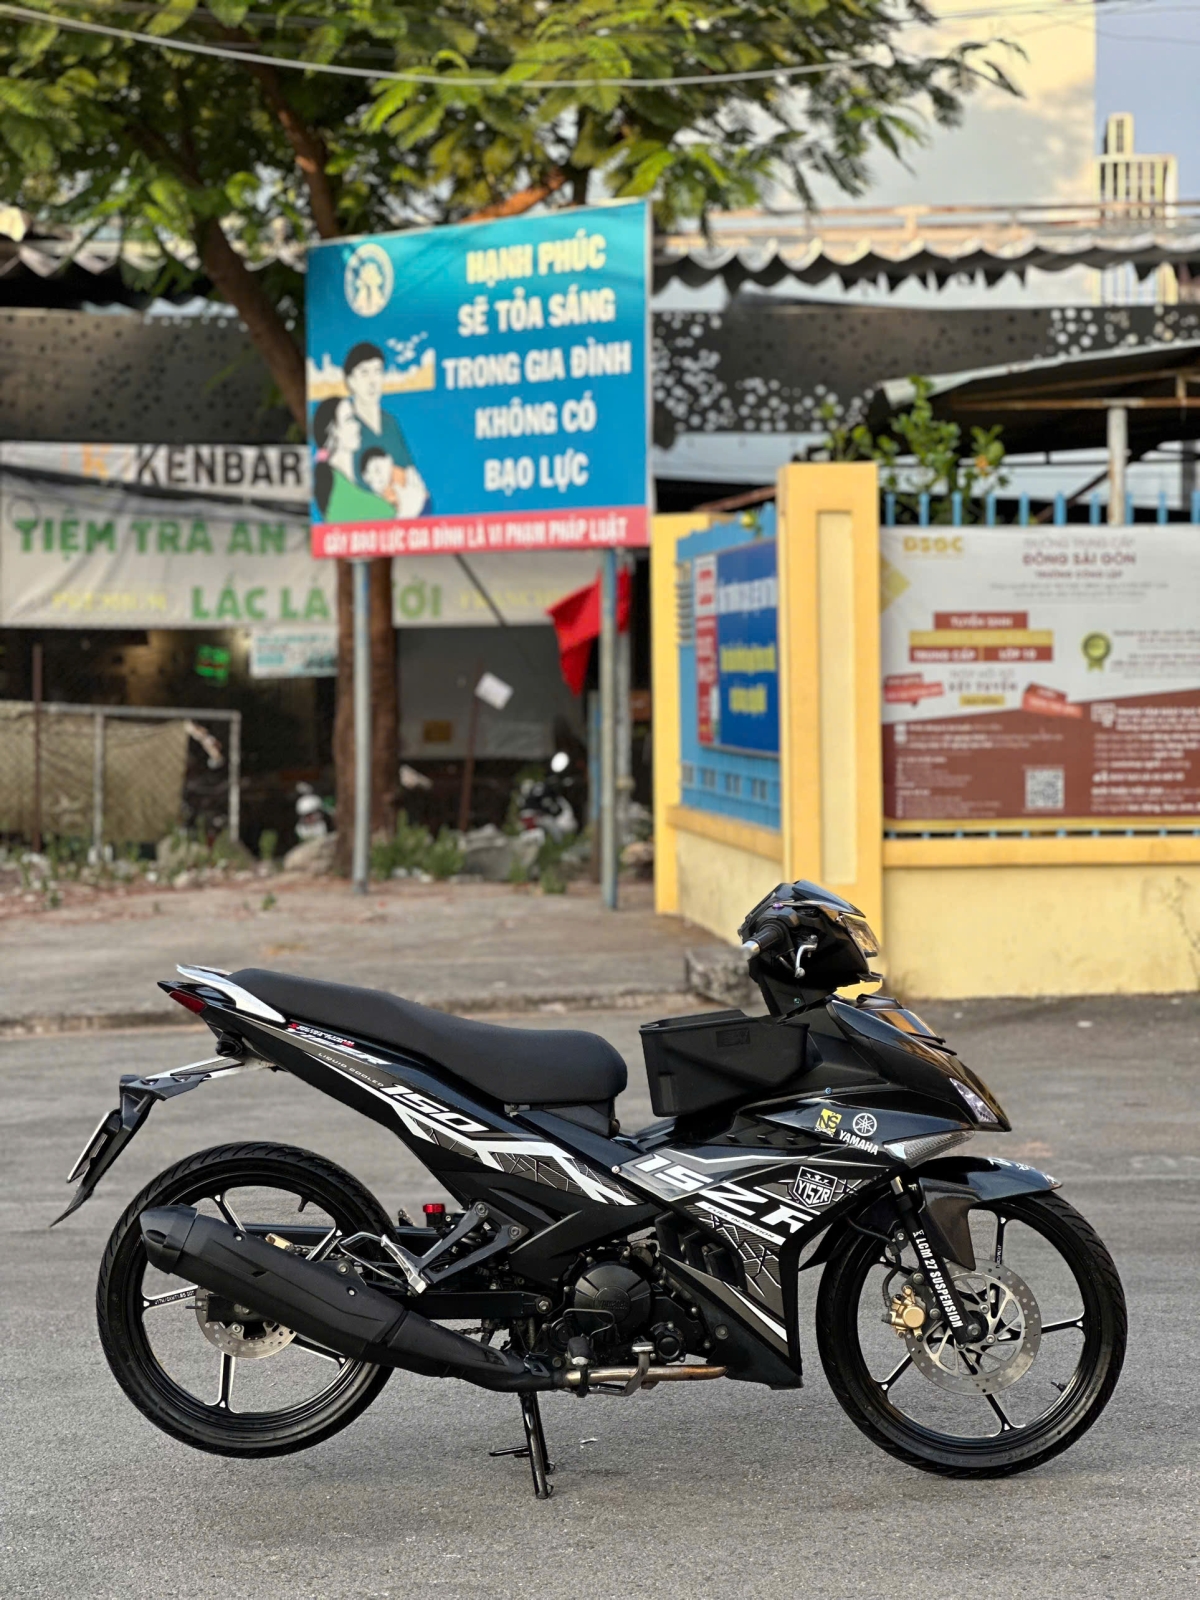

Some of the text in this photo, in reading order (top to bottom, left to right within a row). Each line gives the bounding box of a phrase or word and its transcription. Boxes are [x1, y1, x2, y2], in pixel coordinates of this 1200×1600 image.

[466, 228, 606, 288] HẠNH PHÚC
[458, 283, 616, 337] SẼ TỎA SÁNG
[442, 336, 632, 390] TRONG GIA ĐÌNH
[475, 390, 597, 440] KHÔNG CÓ
[135, 444, 302, 487] KENBAR
[483, 448, 589, 497] BẠO LỰC
[14, 508, 116, 562] TIỆM
[466, 519, 485, 548] LÀ
[488, 523, 503, 547] VI
[318, 1052, 384, 1087] LIQUID COOLED
[379, 1084, 490, 1132] 150
[839, 1129, 879, 1156] YAMAHA
[797, 1179, 831, 1205] Y15ZR
[706, 1205, 776, 1239] FUEL INJECTION
[924, 1258, 939, 1270] 27
[929, 1270, 964, 1328] SUSPENSION
